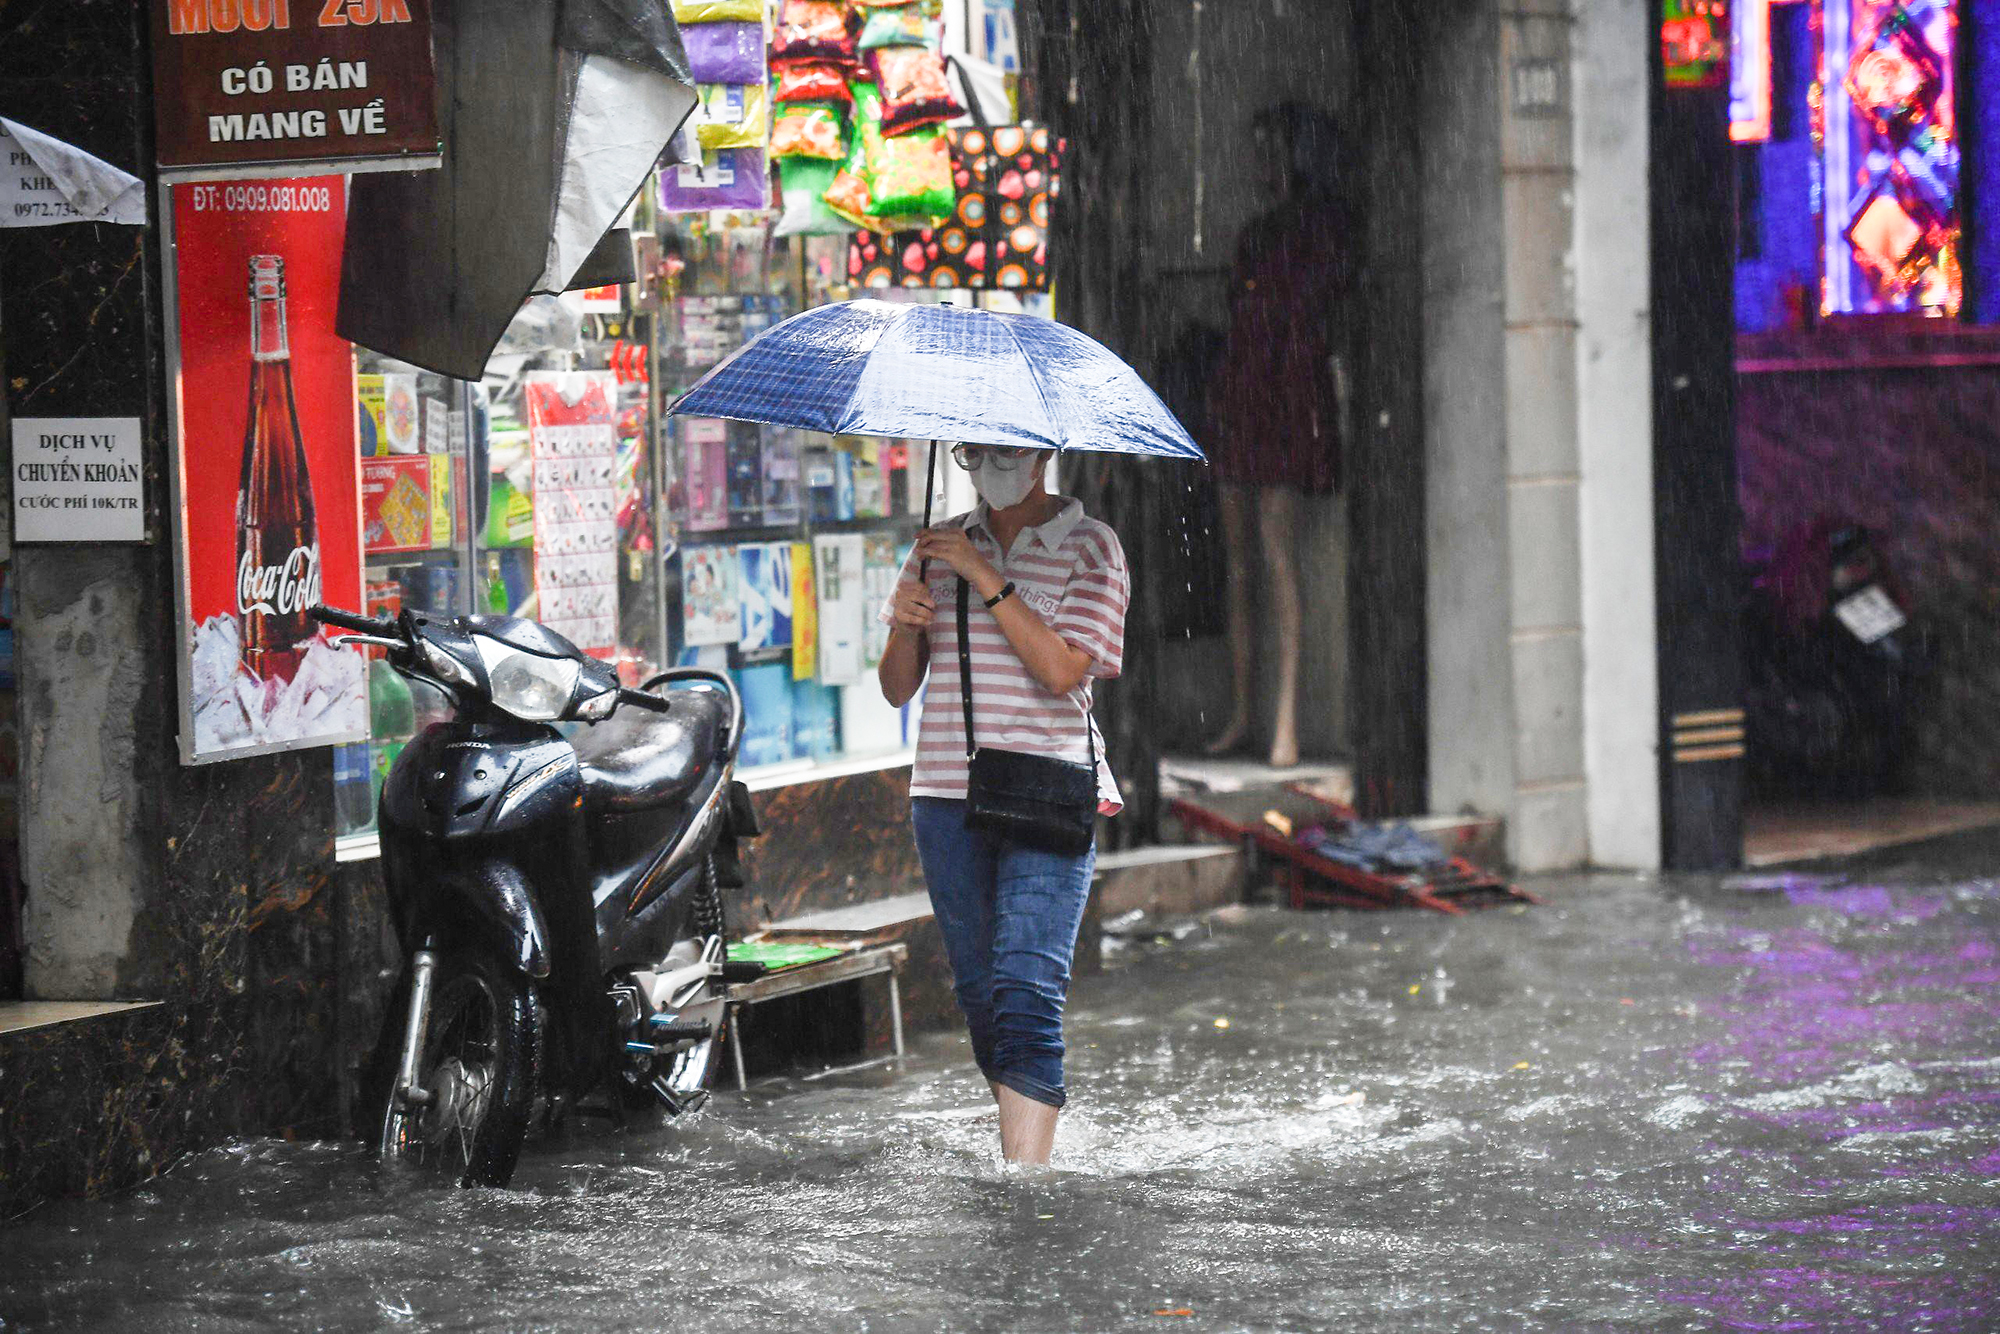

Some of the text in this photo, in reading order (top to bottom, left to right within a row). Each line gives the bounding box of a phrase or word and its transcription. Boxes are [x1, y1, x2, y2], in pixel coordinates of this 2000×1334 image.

[221, 58, 367, 95] CÓ BÁN
[209, 99, 386, 142] MANG VỀ
[193, 186, 330, 212] ĐT: 0909.081.008
[40, 434, 116, 453] DỊCH VỤ
[18, 455, 139, 482] CHUYỂN KHOẢN
[64, 494, 88, 509] PHÍ
[92, 497, 139, 509] 10K/TR
[445, 741, 492, 749] HONDA
